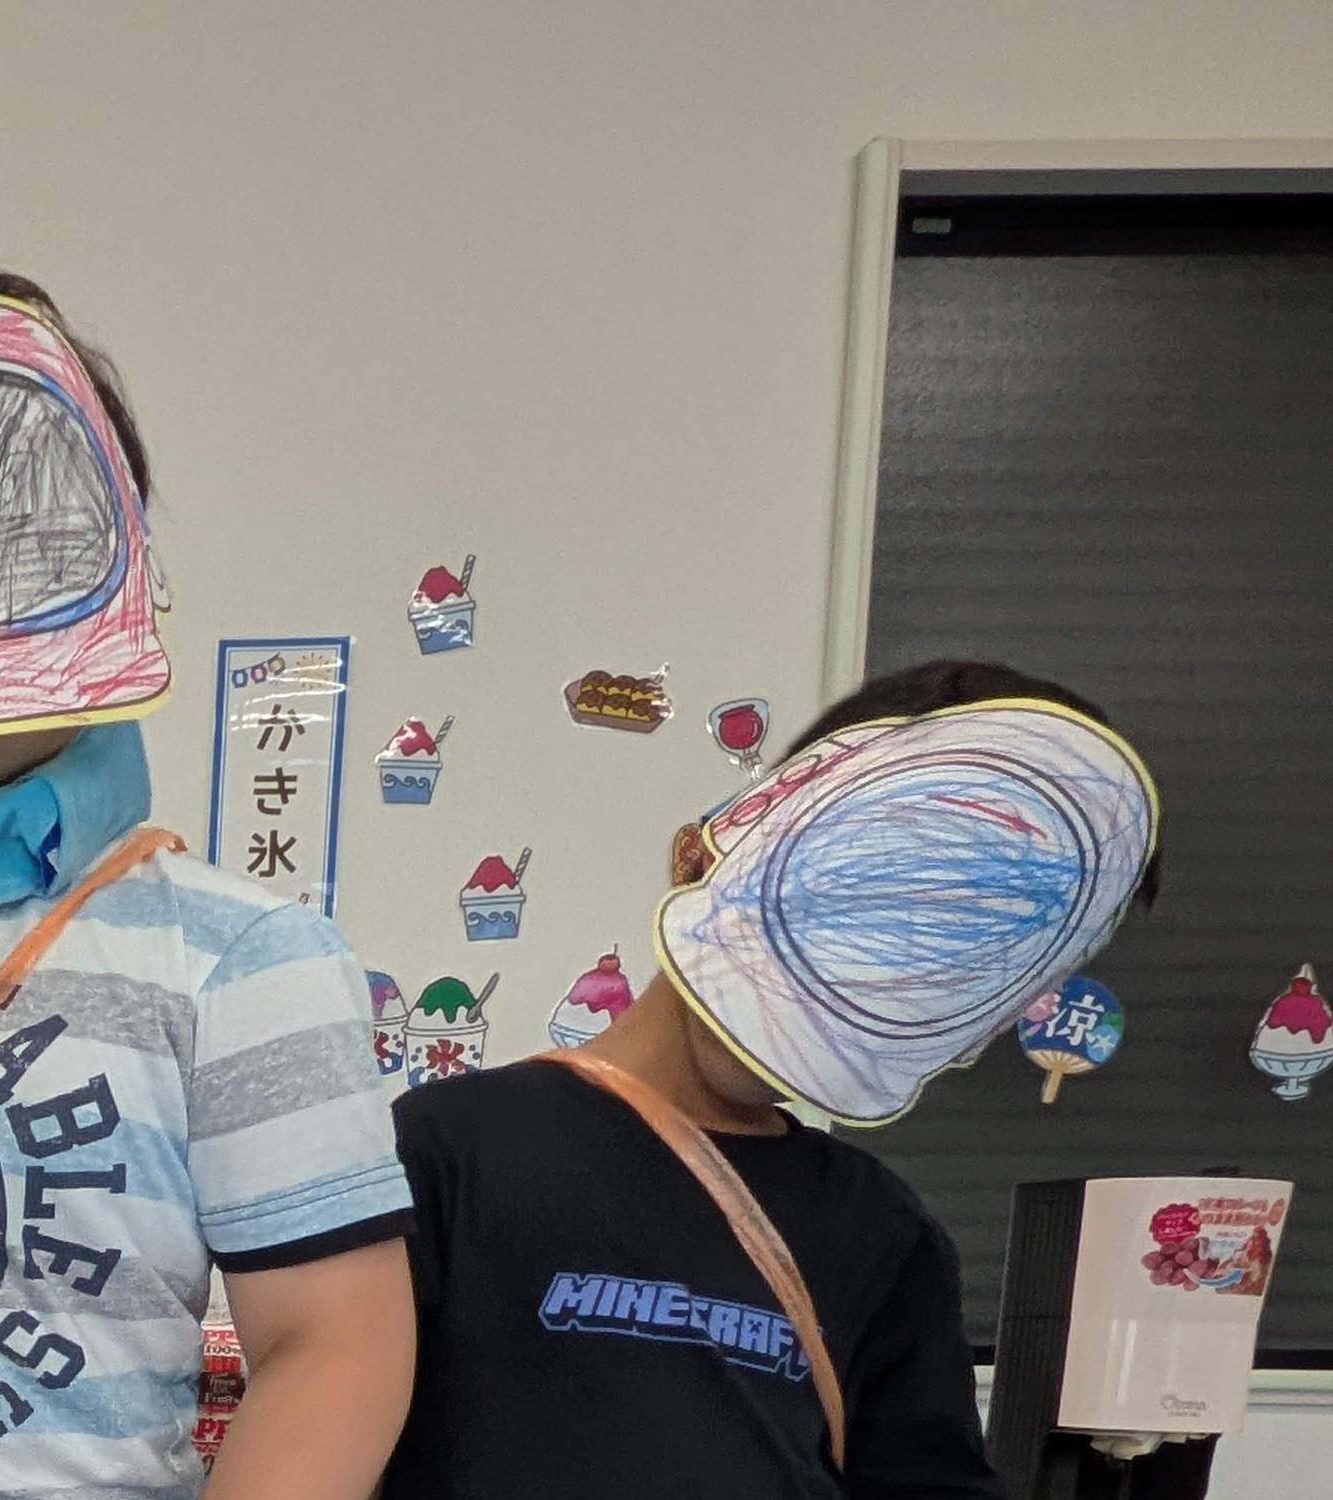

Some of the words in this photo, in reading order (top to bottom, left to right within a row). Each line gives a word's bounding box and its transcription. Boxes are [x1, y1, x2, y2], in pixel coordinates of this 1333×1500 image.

[247, 703, 306, 878] かき氷
[1044, 993, 1106, 1047] 涼
